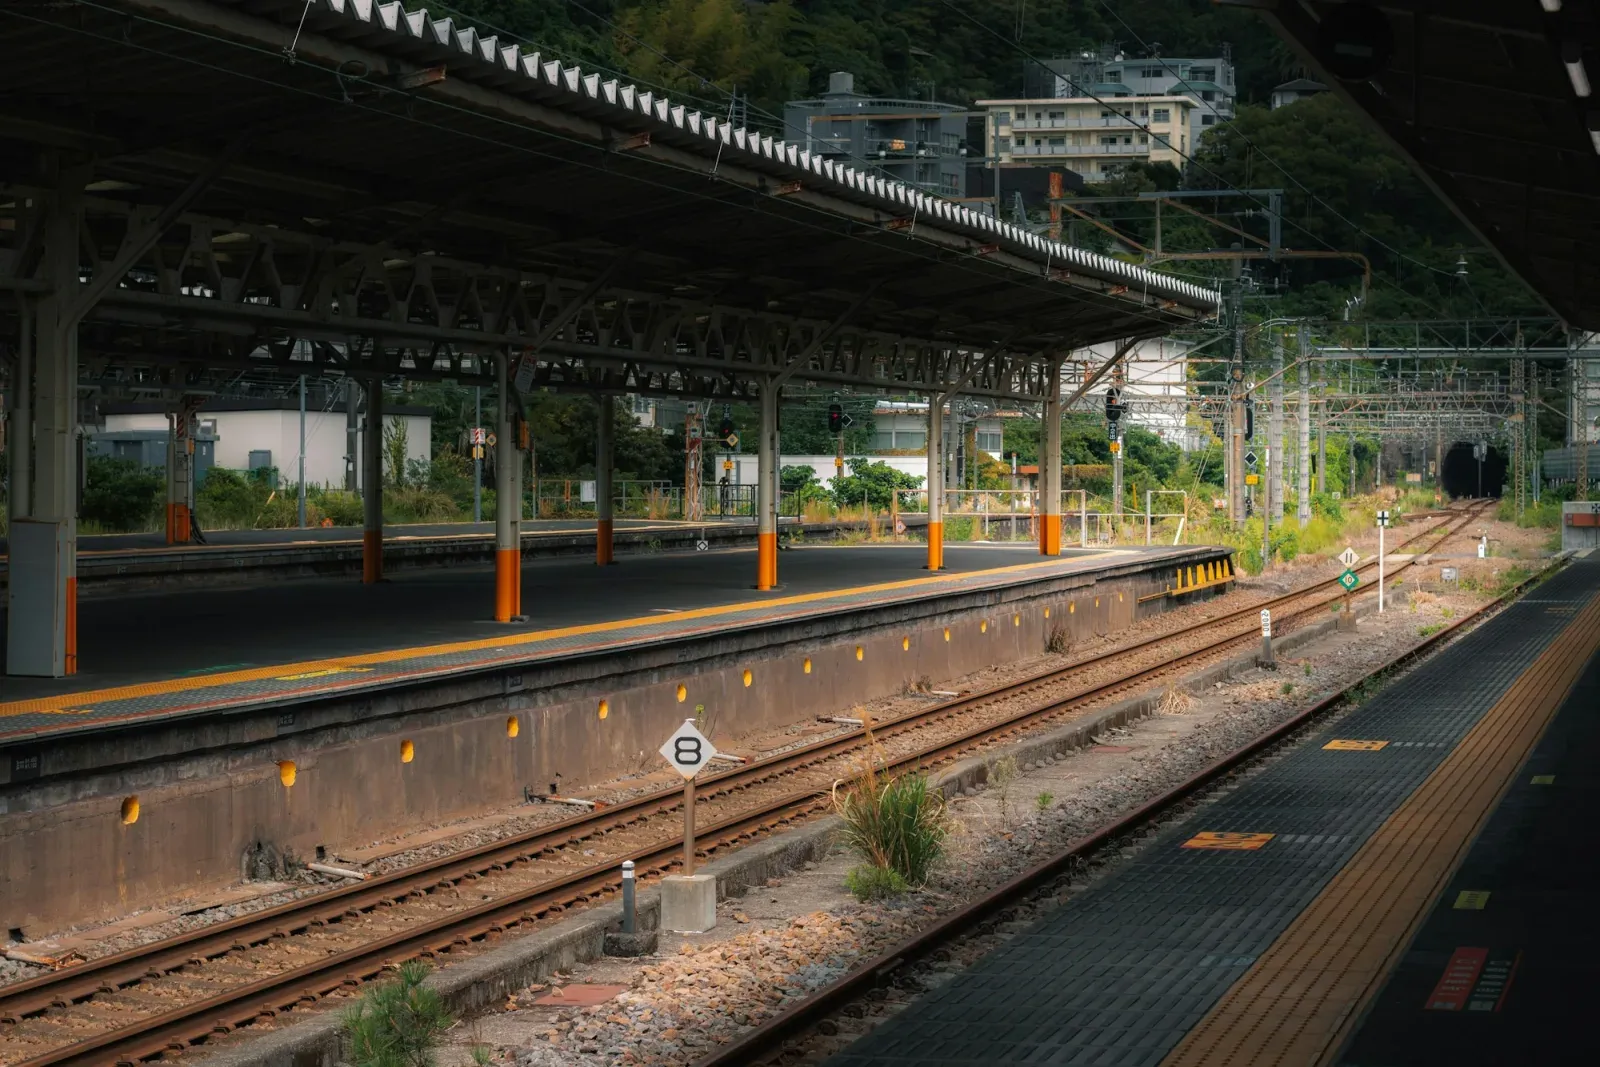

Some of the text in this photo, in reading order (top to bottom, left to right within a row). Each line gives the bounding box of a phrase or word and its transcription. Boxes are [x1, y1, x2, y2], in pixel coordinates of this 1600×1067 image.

[1345, 552, 1353, 564] 11
[1344, 576, 1353, 584] 10
[674, 736, 702, 765] 8
